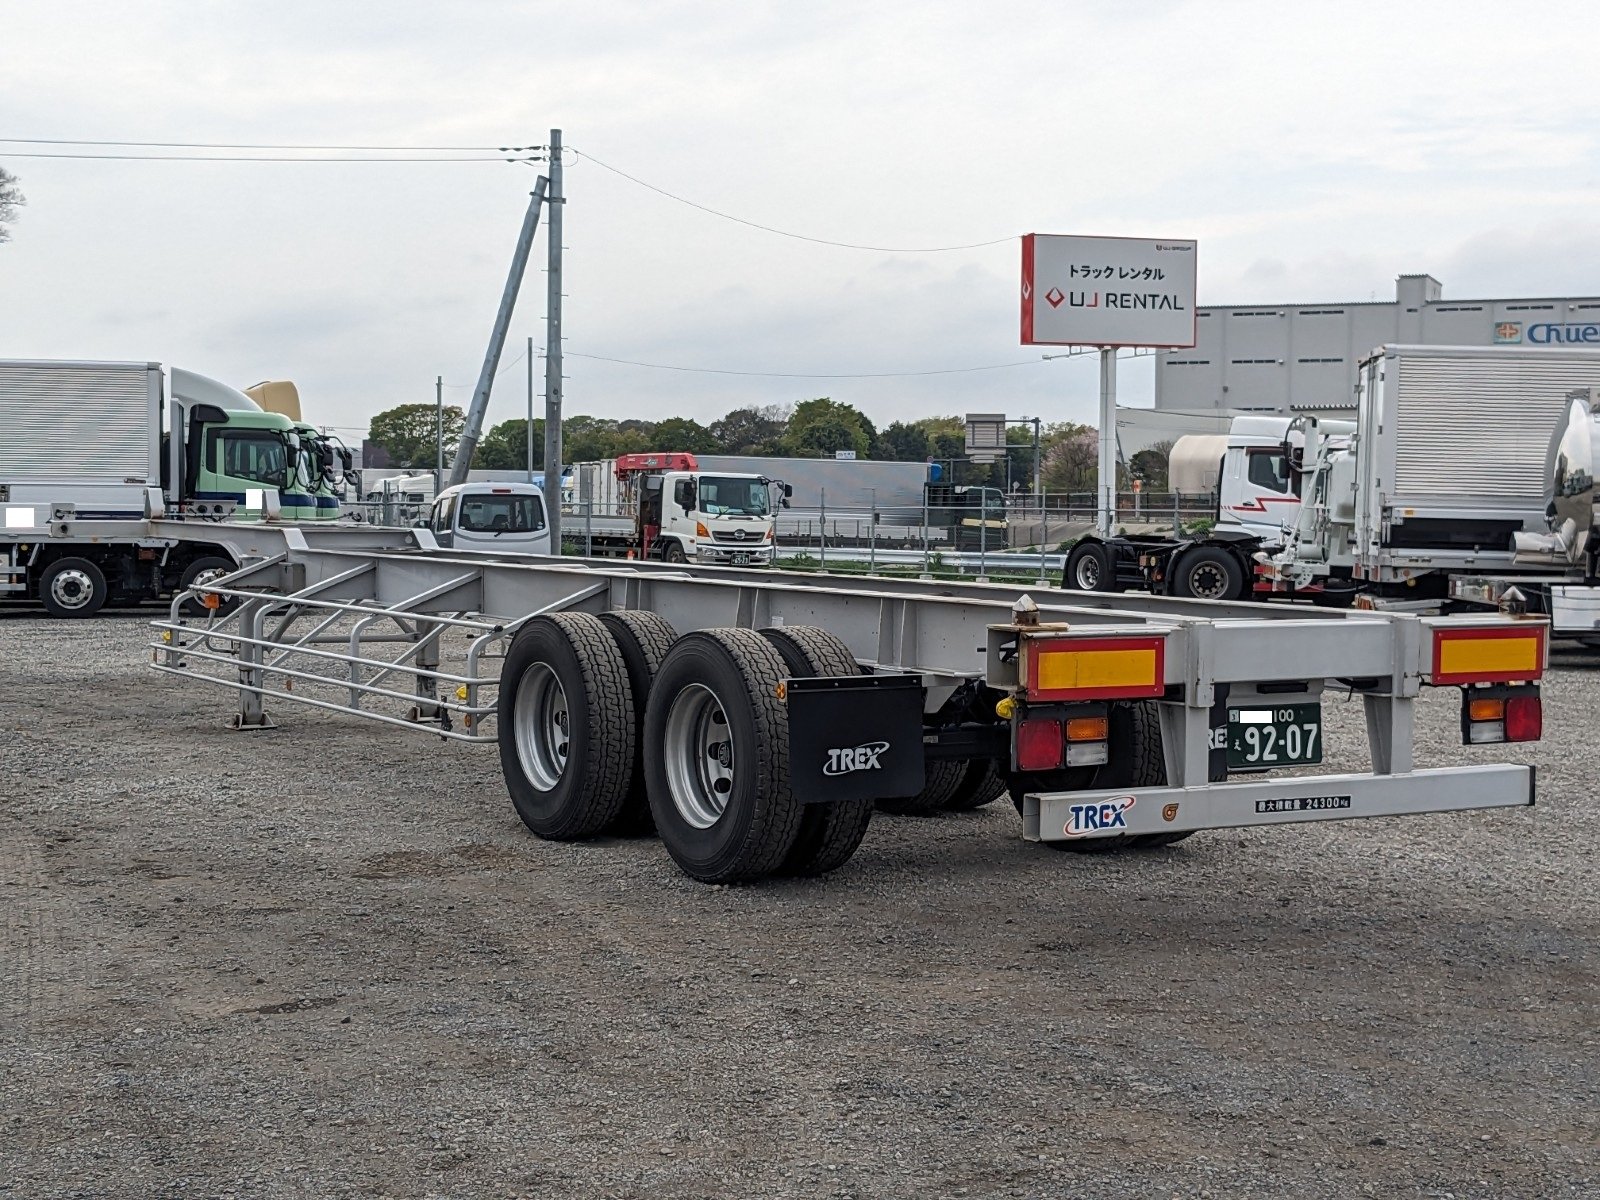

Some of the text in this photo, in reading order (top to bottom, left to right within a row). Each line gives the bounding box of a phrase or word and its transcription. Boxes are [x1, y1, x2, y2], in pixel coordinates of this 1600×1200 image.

[1070, 264, 1165, 280] トラック レンタル
[1105, 293, 1184, 310] RENTAL
[1527, 323, 1600, 344] Chue
[1273, 709, 1295, 723] 100
[1244, 723, 1318, 761] 92-07
[826, 745, 884, 773] TREX
[1068, 802, 1128, 831] TREX
